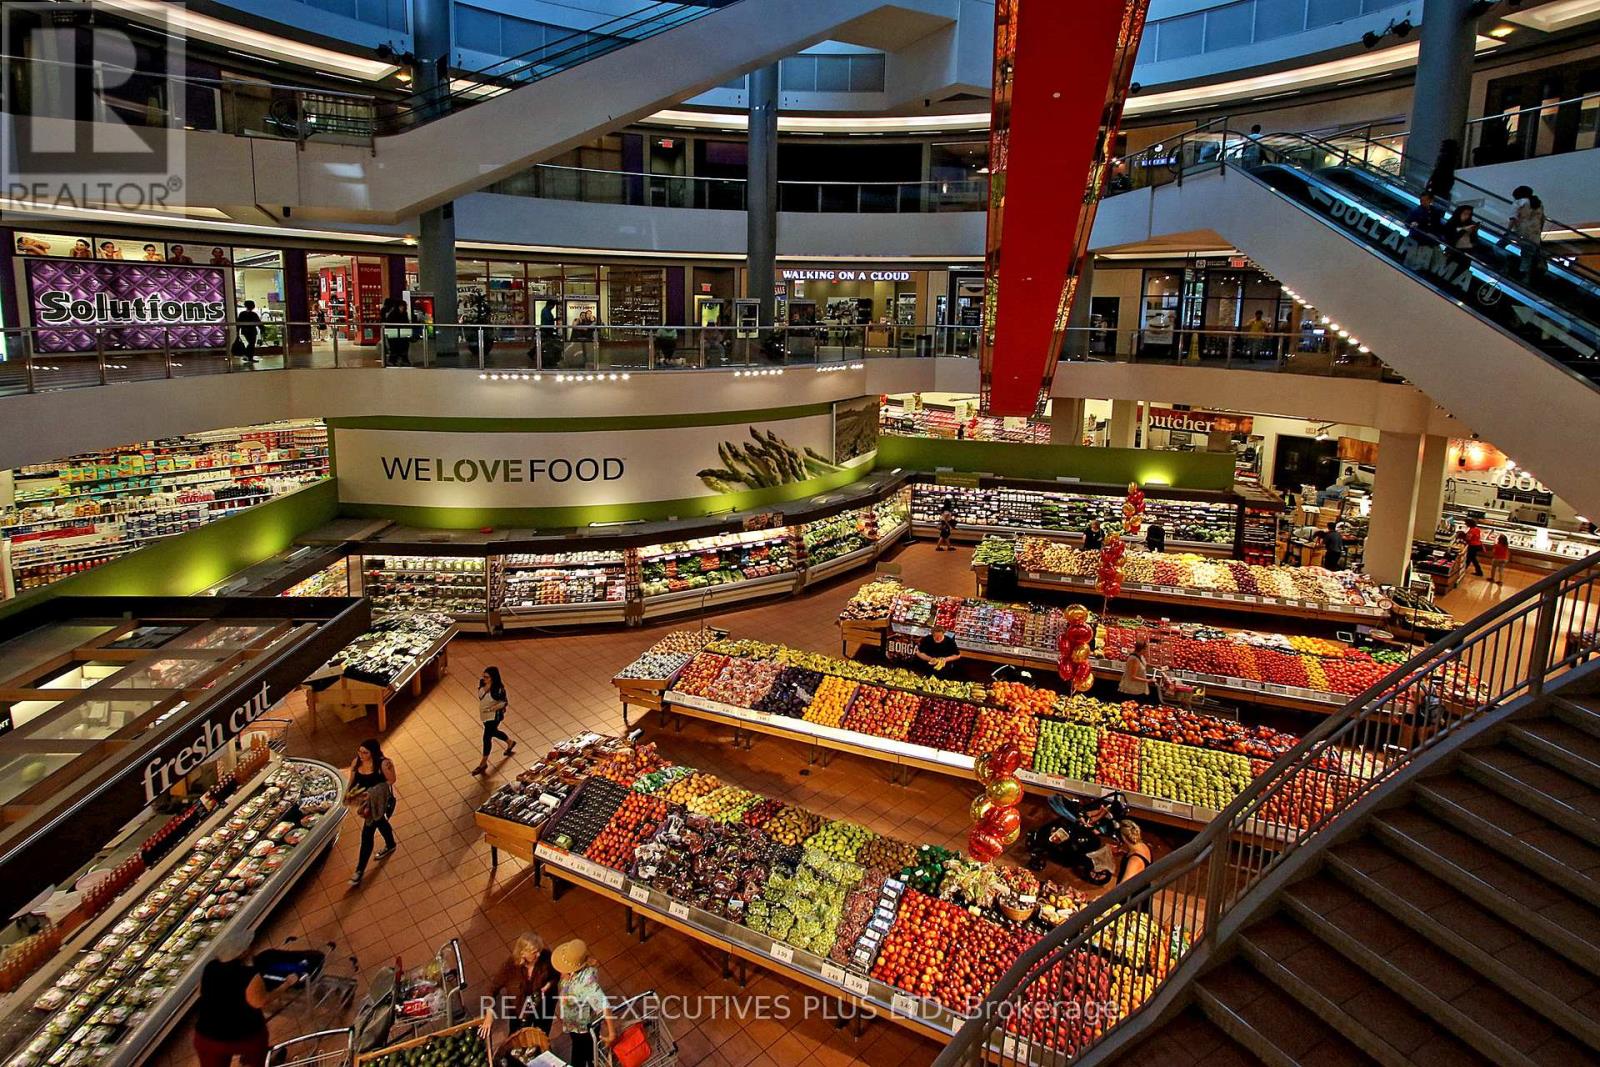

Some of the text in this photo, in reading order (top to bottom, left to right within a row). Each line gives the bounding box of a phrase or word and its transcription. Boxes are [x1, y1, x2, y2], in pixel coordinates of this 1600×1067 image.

[783, 270, 909, 280] WALKING ON A CLOUD
[40, 291, 225, 323] Solutions
[381, 457, 430, 481] WE
[436, 458, 522, 482] LOVE
[141, 680, 272, 806] fresh cut
